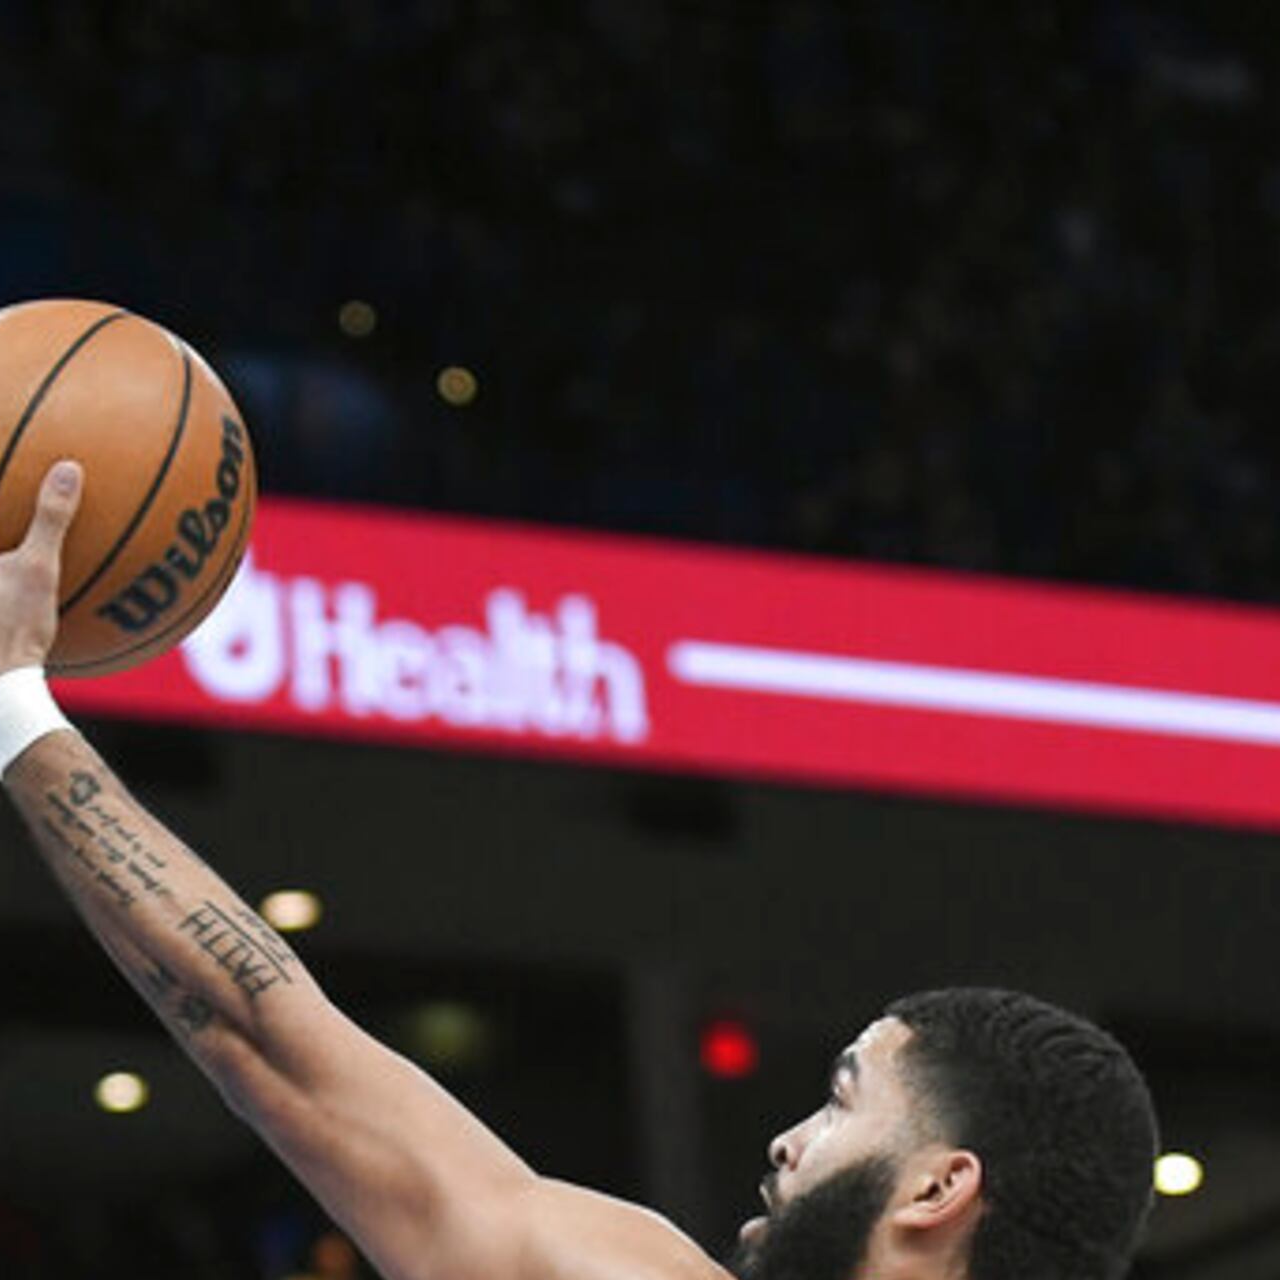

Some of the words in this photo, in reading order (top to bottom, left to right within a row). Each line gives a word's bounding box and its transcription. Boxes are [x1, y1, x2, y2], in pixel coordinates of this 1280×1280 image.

[99, 415, 244, 633] Wilson
[291, 576, 648, 745] Health
[179, 907, 280, 999] FAITH
